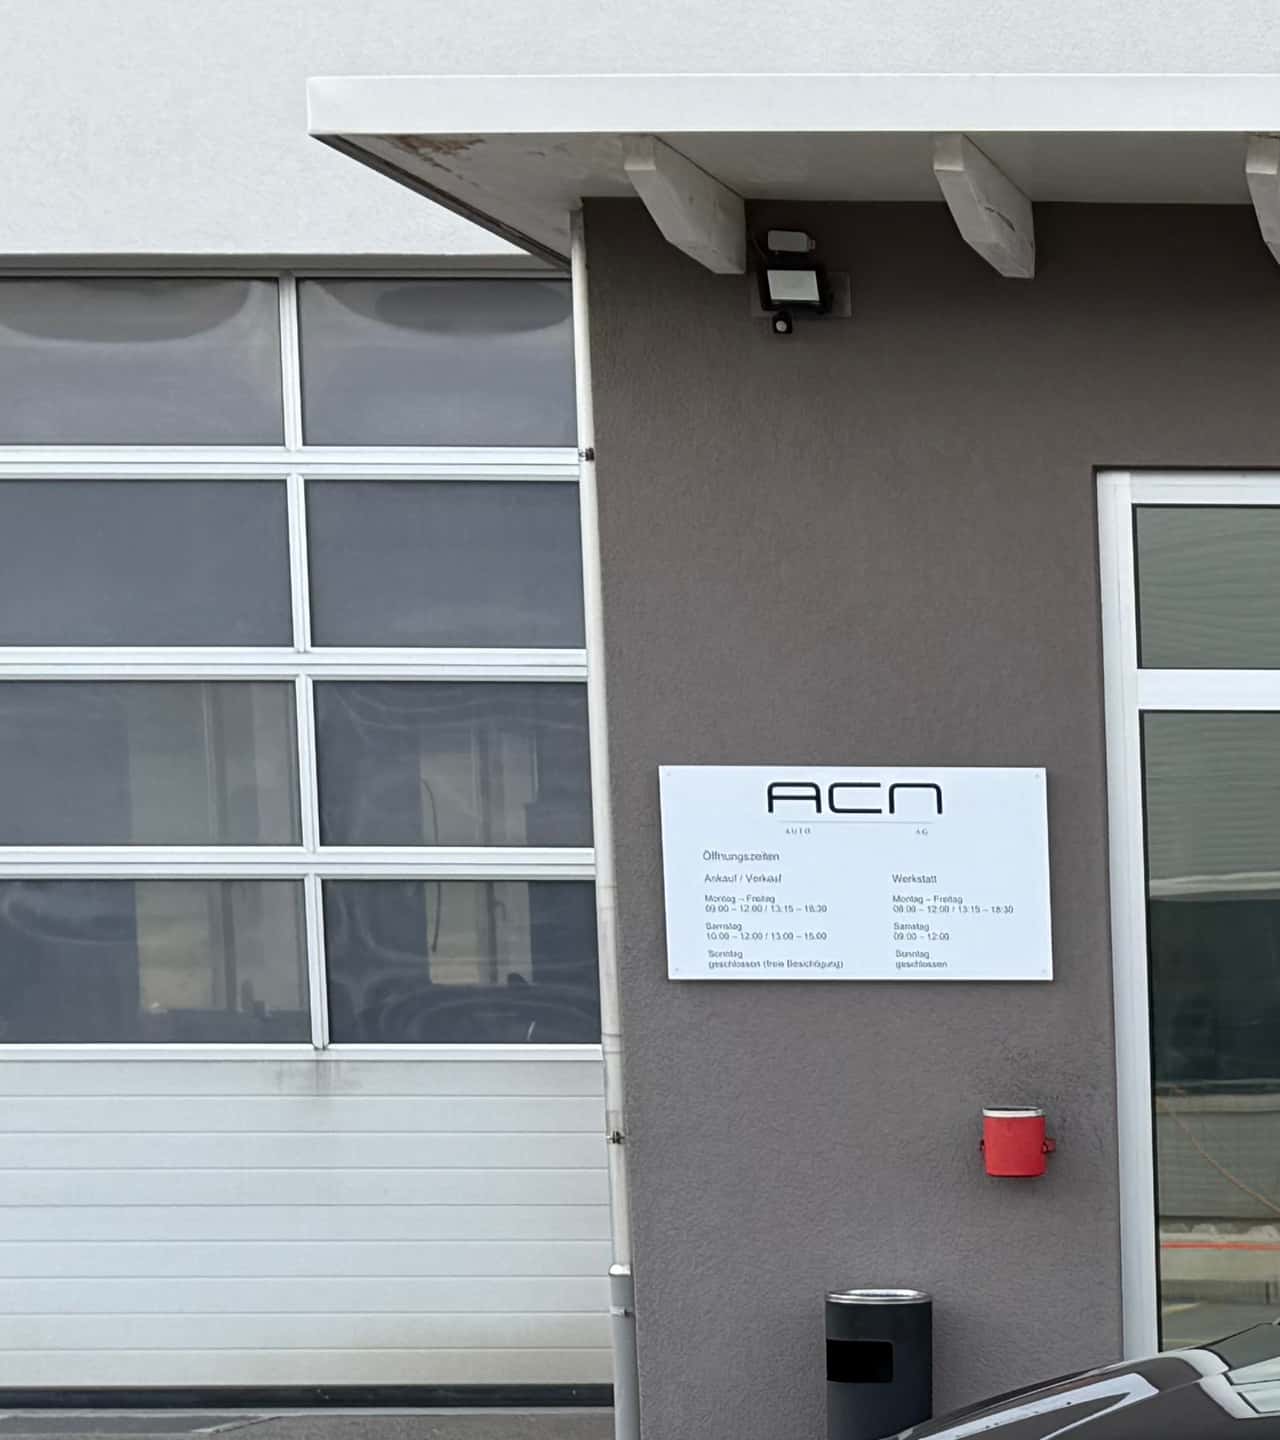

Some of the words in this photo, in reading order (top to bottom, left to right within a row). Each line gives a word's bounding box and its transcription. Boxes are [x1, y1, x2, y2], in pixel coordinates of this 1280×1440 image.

[767, 782, 943, 815] ACN
[702, 849, 780, 864] Öffnungszeiten
[704, 873, 737, 883] Ankauf
[745, 873, 783, 883] Verkauf
[892, 873, 937, 883] Werkstatt
[704, 894, 736, 904] Montag
[746, 894, 776, 904] Freitag
[892, 895, 924, 904] Montag
[933, 895, 963, 904] Freitag
[705, 922, 742, 932] Samstag
[893, 922, 930, 932] Samstag
